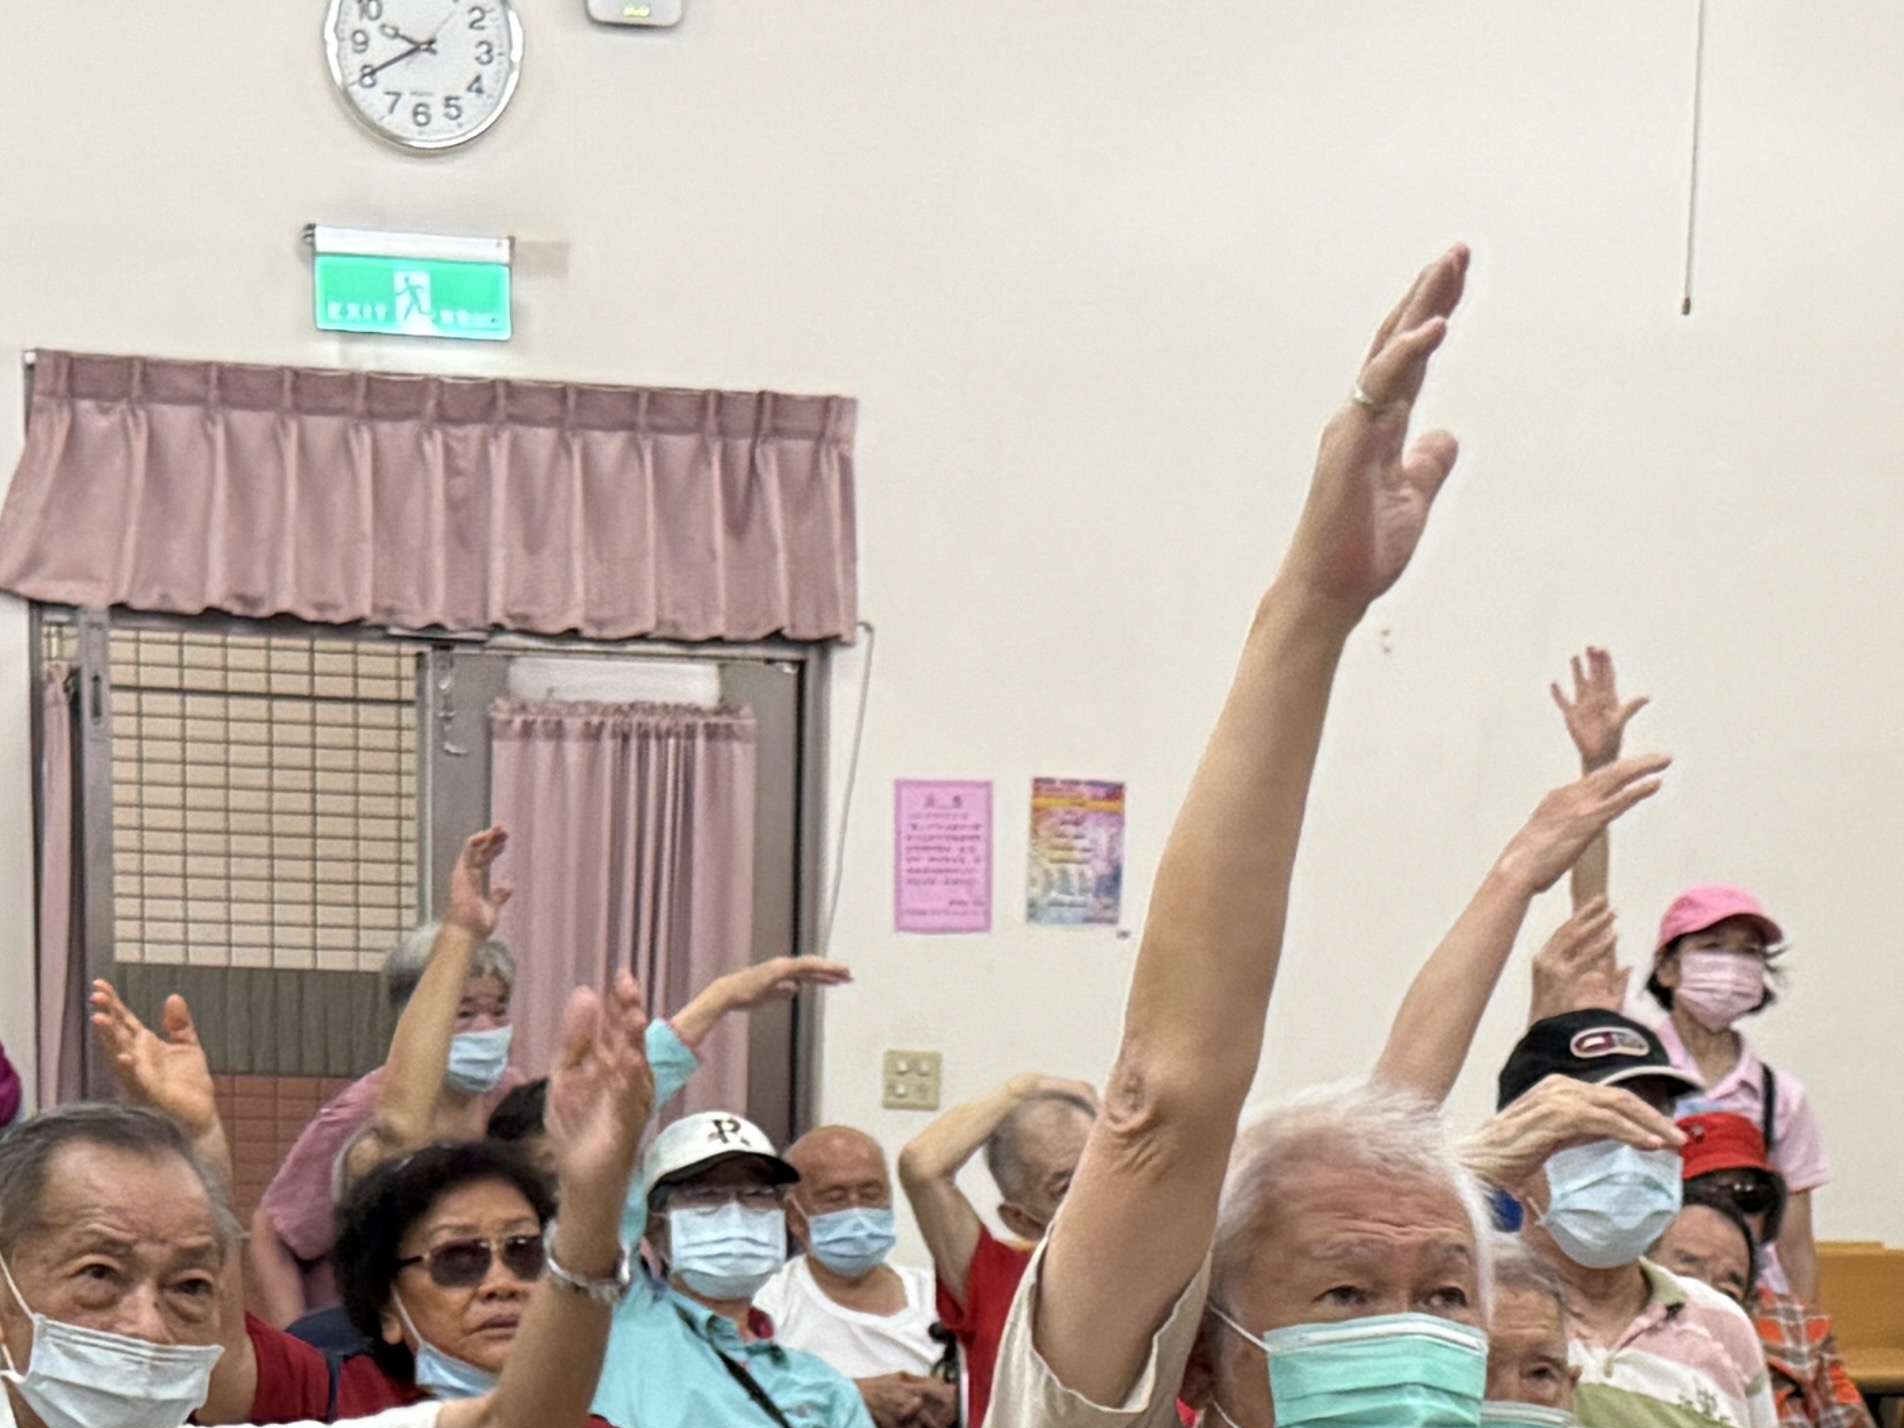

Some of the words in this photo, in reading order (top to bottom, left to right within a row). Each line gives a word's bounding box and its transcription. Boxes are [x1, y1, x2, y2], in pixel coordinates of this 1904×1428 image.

[468, 6, 486, 30] 2
[351, 29, 369, 54] 9
[475, 40, 494, 65] 3
[359, 64, 377, 88] 8
[466, 74, 484, 95] 4
[384, 91, 402, 114] 7
[443, 96, 462, 120] 5
[412, 103, 431, 127] 6
[327, 301, 388, 322] EXIT
